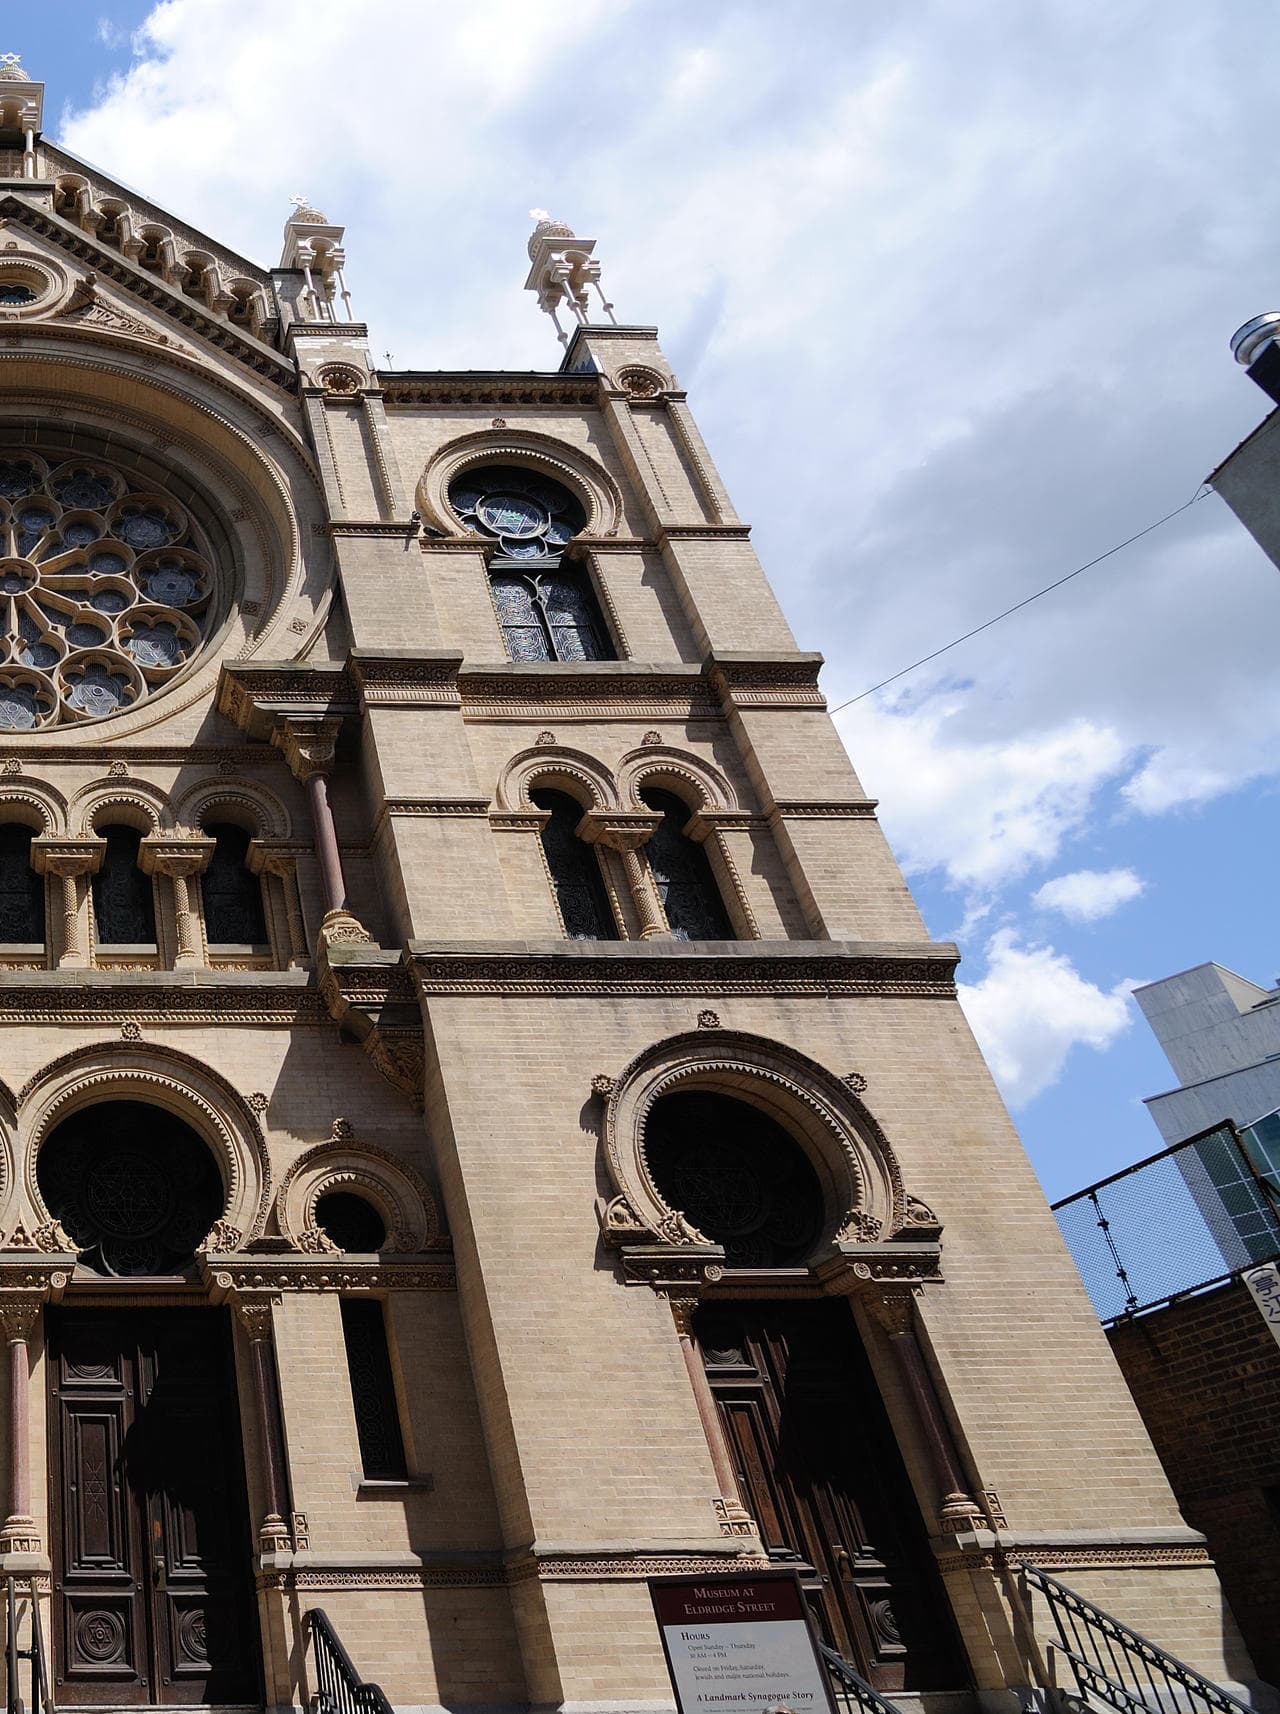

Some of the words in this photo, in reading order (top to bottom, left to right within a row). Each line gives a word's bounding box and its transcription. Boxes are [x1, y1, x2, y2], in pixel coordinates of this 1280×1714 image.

[693, 1588, 739, 1599] MUSEUM
[684, 1602, 735, 1615] ELDRIDGE
[737, 1601, 775, 1613] STREET
[680, 1631, 710, 1640] HOURS
[704, 1692, 746, 1701] Landmark
[747, 1692, 790, 1702] Synagogue
[792, 1690, 814, 1700] Story
